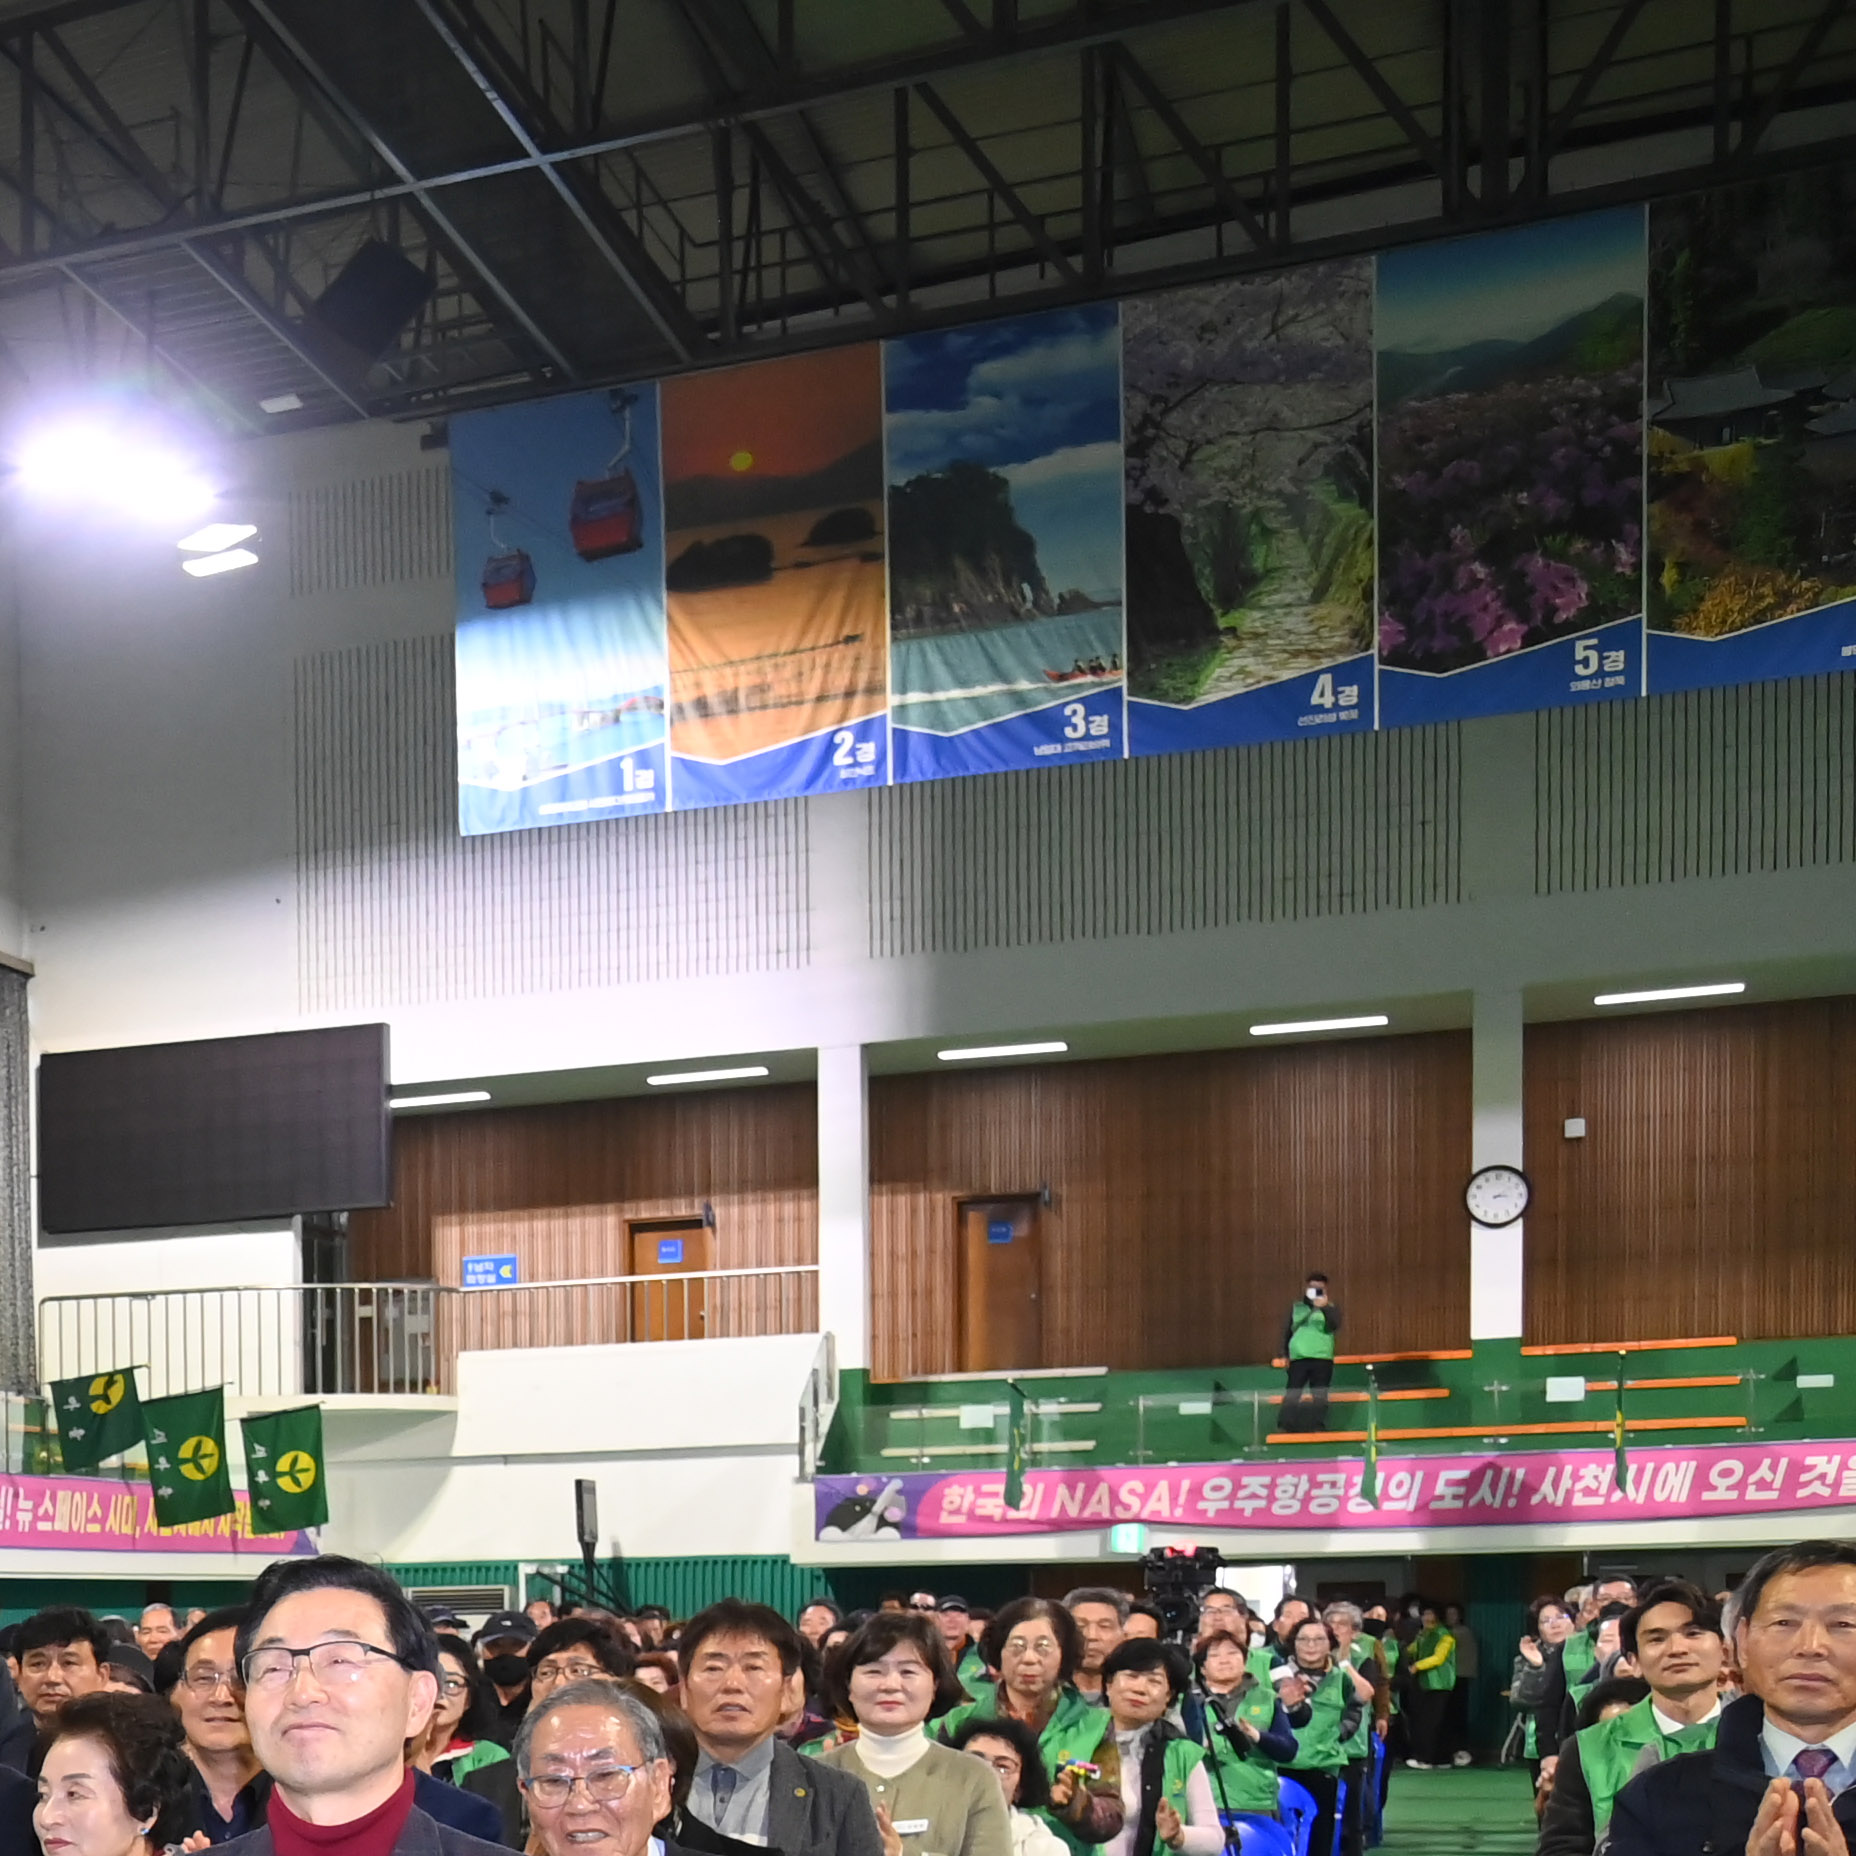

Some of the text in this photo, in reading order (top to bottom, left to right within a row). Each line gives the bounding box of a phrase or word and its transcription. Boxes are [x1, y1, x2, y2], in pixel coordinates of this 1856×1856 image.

[1574, 638, 1625, 677] 5경
[1310, 673, 1359, 709] 4경
[1063, 703, 1110, 739] 3경
[1050, 1479, 1191, 1521] NASA!
[1429, 1466, 1523, 1510] 도시!
[1530, 1461, 1697, 1507] 사천시에
[1701, 1457, 1788, 1502] 오신
[15, 1487, 34, 1533] 뉴
[36, 1489, 103, 1534] 스페이스
